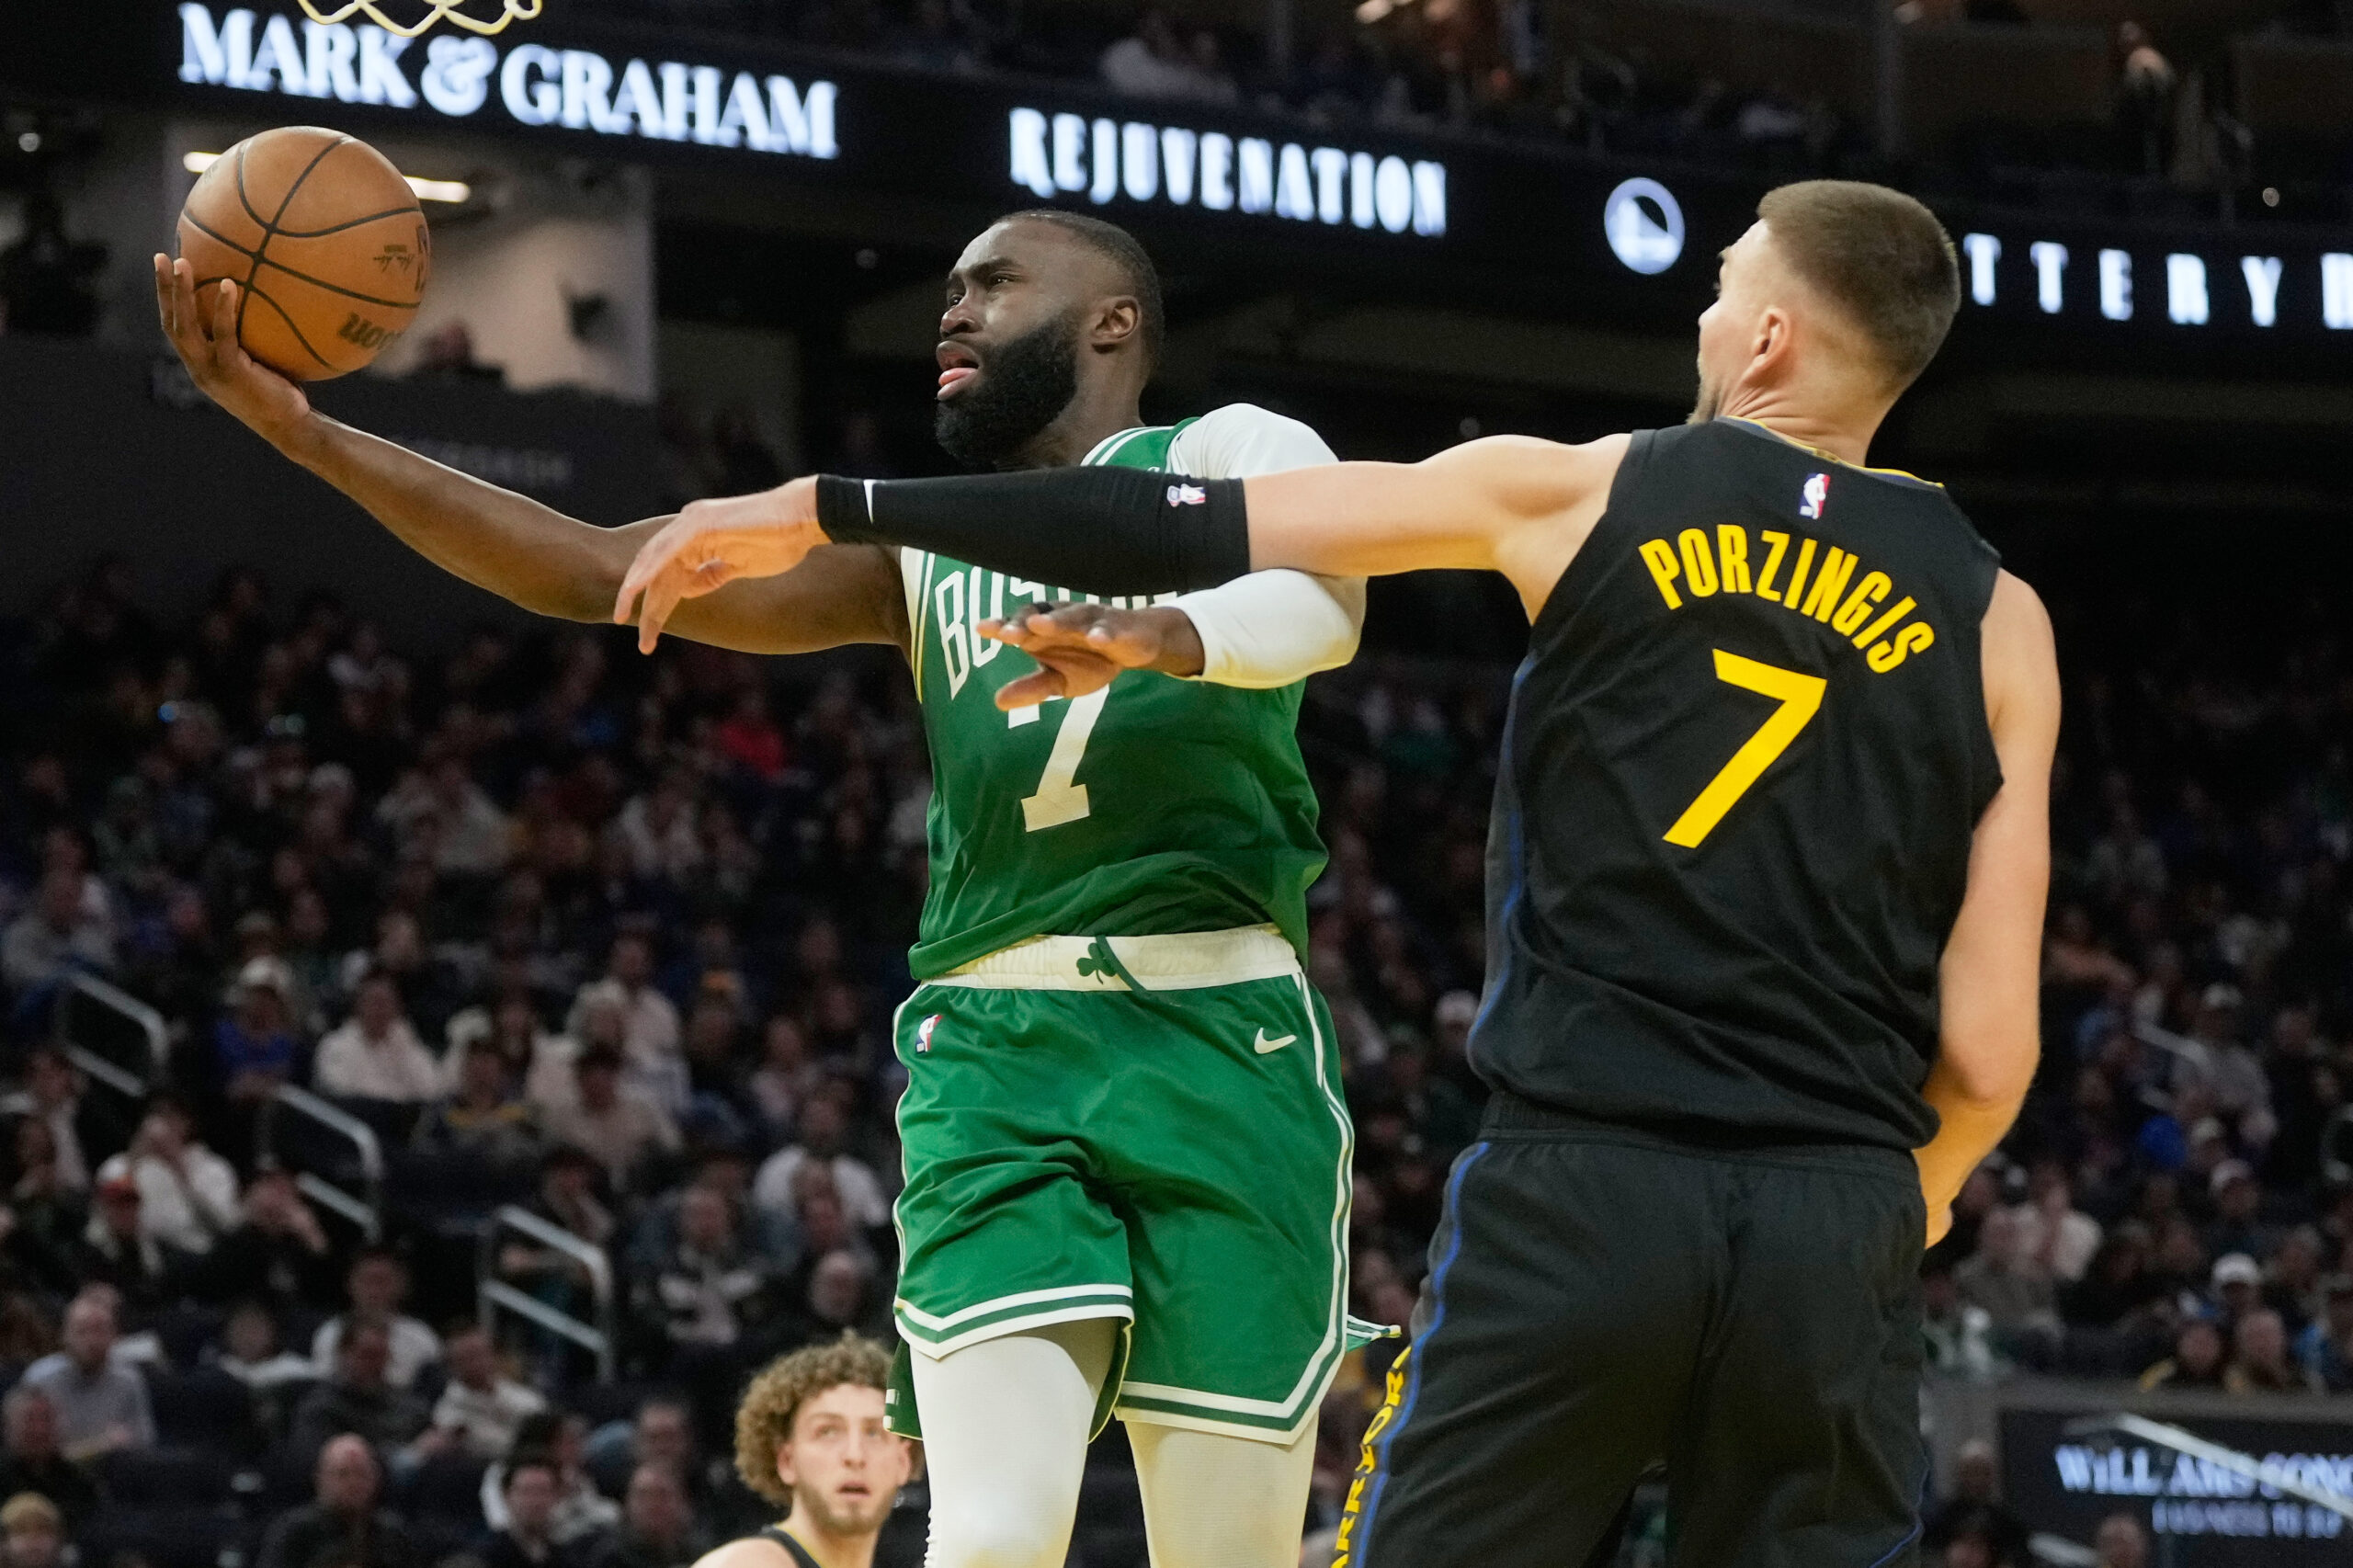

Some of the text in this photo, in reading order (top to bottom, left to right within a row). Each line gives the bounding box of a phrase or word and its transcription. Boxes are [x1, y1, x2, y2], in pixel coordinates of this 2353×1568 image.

[178, 4, 838, 159] MARK & GRAHAM
[1009, 107, 1446, 237] REJUVENATION
[1638, 524, 1935, 674] PORZINGIS
[1008, 684, 1110, 833] 7
[1662, 648, 1827, 849] 7
